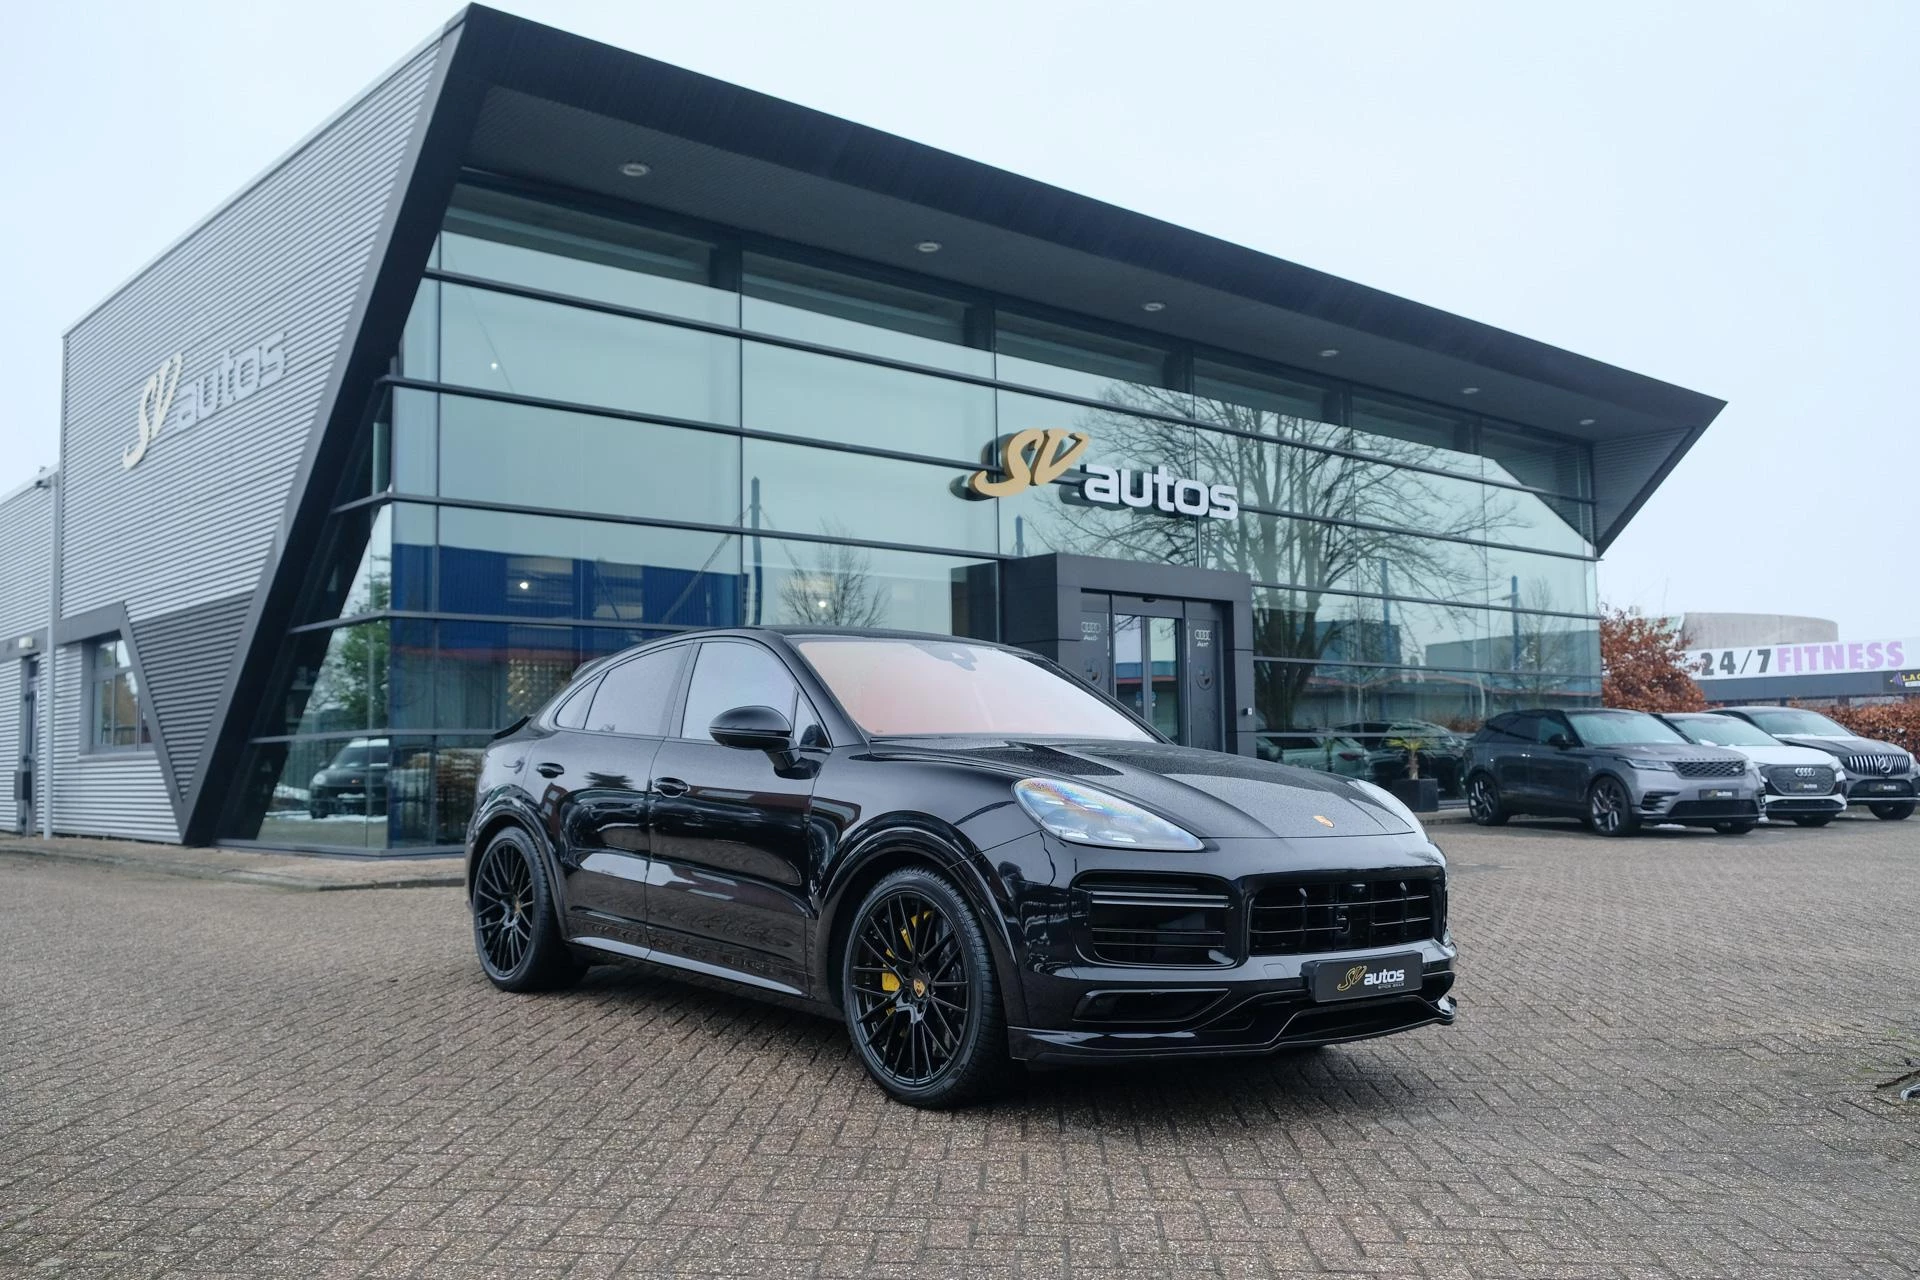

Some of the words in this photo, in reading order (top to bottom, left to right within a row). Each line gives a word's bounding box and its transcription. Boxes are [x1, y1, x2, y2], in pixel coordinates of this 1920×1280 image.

[176, 331, 288, 431] autos
[1082, 463, 1239, 520] autos
[1700, 648, 1772, 676] 24/7
[1777, 640, 1905, 673] FITNESS
[1363, 968, 1405, 986] autos
